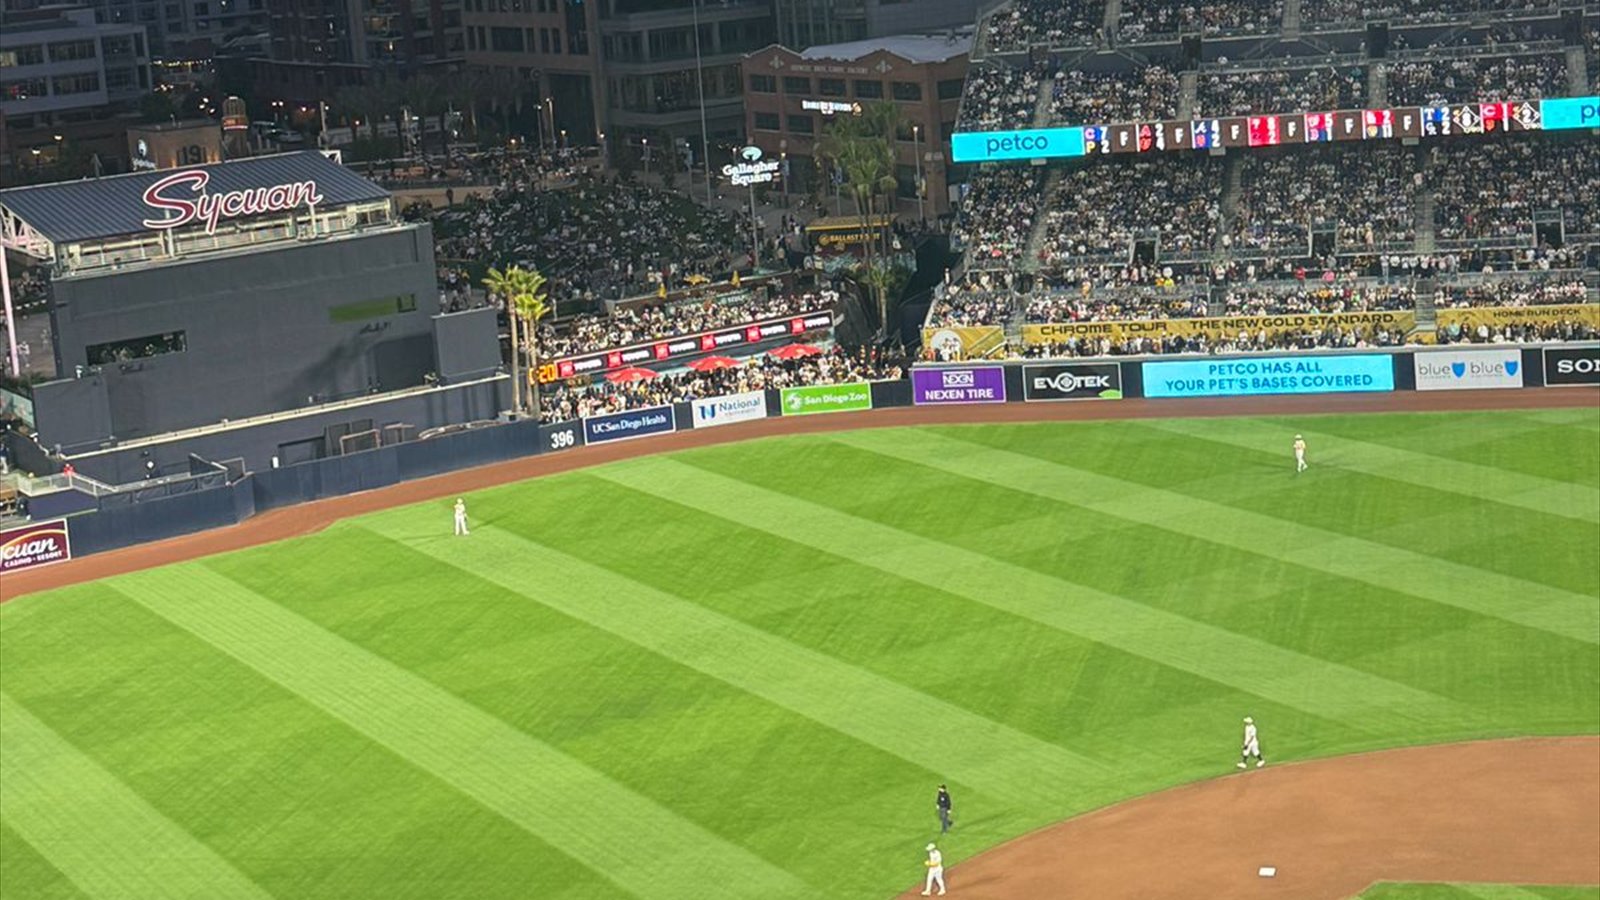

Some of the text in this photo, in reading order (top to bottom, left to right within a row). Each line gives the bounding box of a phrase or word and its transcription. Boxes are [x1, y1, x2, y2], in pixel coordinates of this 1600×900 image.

[1581, 104, 1600, 124] p
[1288, 121, 1296, 137] F
[1345, 119, 1353, 133] F
[1403, 115, 1412, 131] F
[1120, 131, 1128, 146] F
[1175, 128, 1183, 143] F
[1231, 125, 1239, 140] F
[987, 133, 1048, 156] petco
[1101, 140, 1110, 153] 2
[722, 161, 780, 176] Gallagher
[731, 173, 772, 187] Square
[142, 170, 324, 236] Sycuan
[1493, 308, 1581, 318] HOME RUN DECK
[1040, 322, 1167, 335] CHROME TOUR
[1190, 313, 1398, 330] THE NEW GOLD STANDARD.
[1208, 361, 1323, 375] PETCO HAS ALL
[1418, 363, 1451, 375] blue
[1470, 362, 1503, 374] blue
[1034, 372, 1110, 392] EVOTEK
[1165, 374, 1374, 391] YOUR PET'S BASES COVERED
[804, 392, 867, 405] San Diego Zoo
[925, 388, 995, 400] NEXEN TIRE
[719, 397, 760, 411] National
[620, 419, 641, 430] Diego
[641, 414, 667, 426] Health
[551, 430, 575, 449] 396
